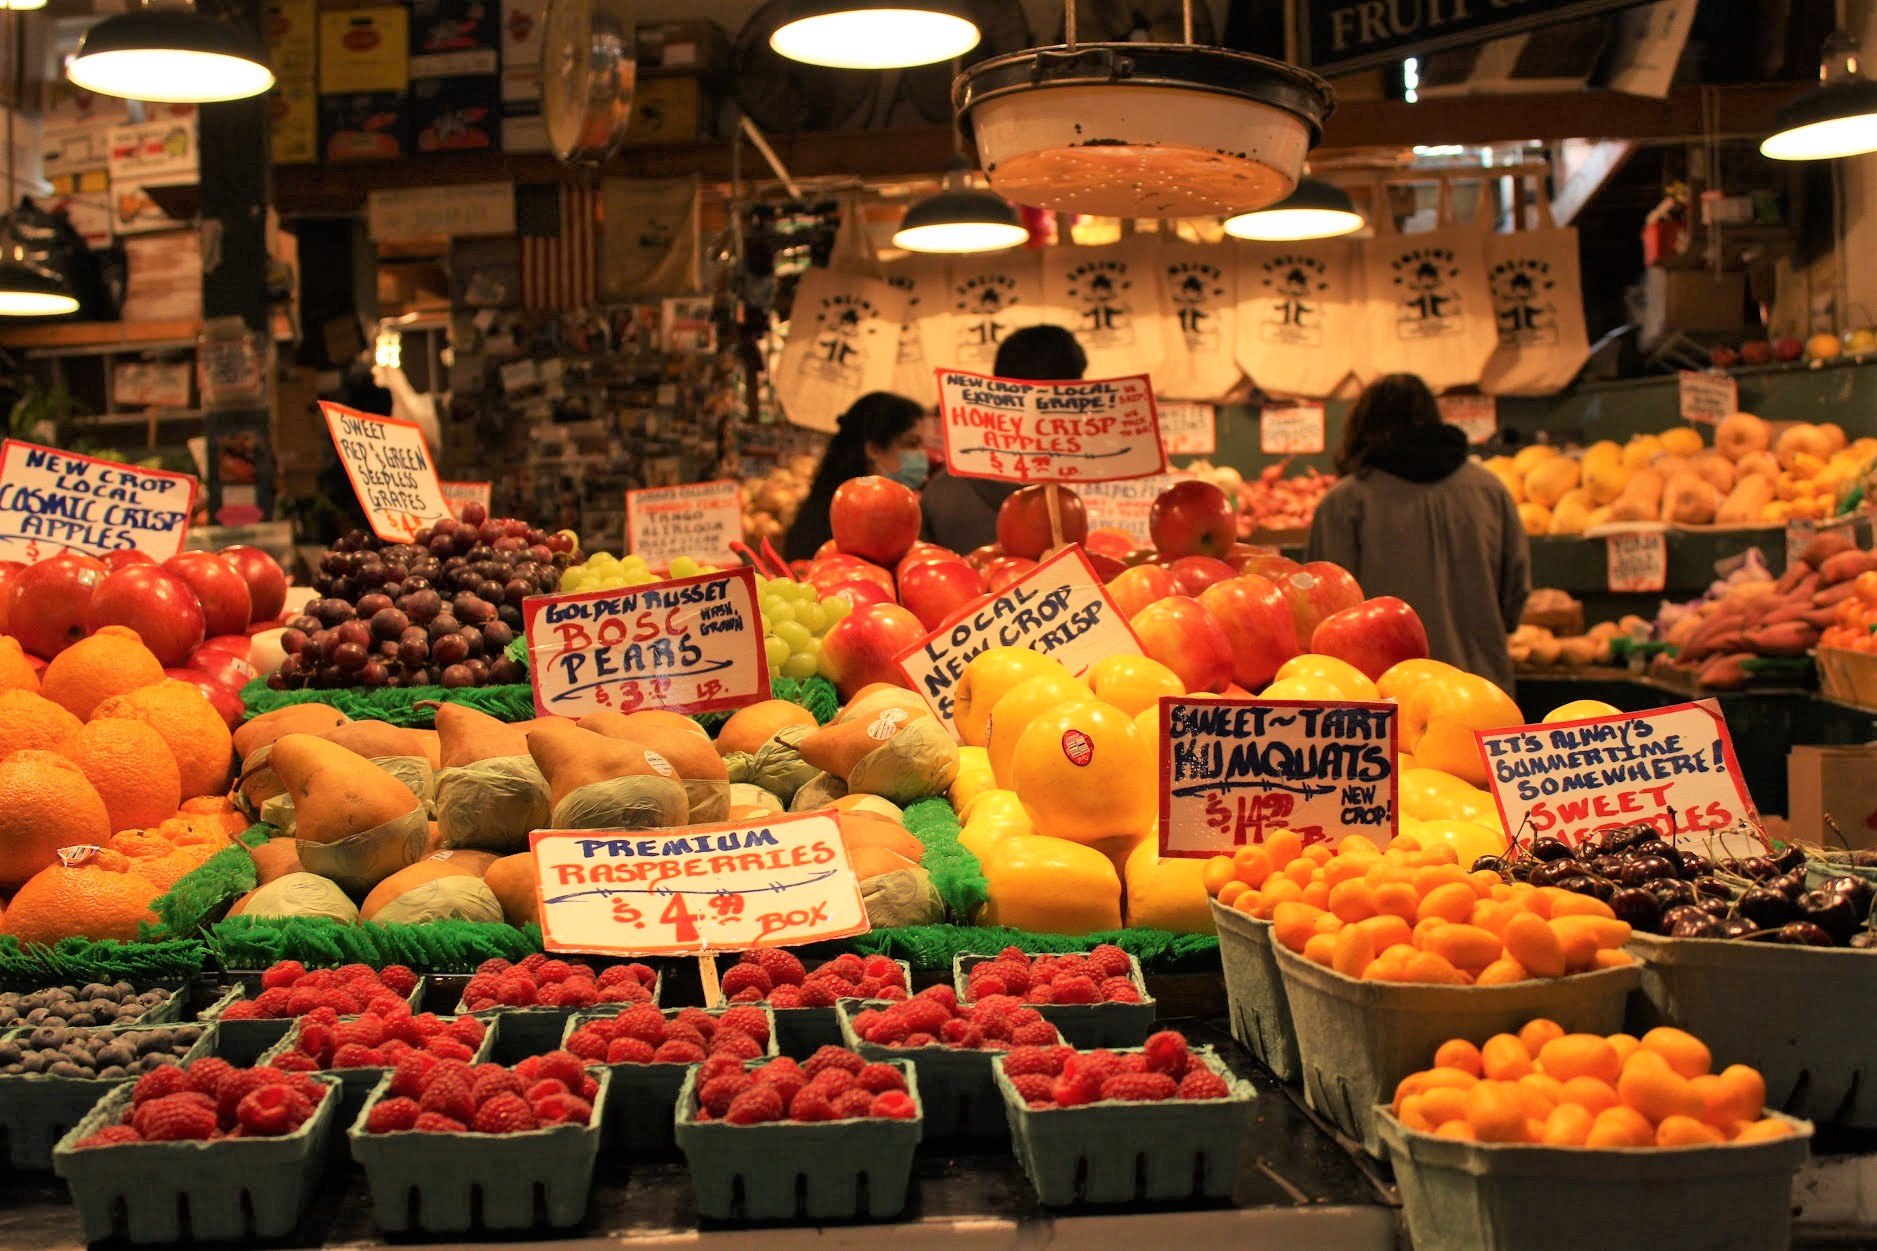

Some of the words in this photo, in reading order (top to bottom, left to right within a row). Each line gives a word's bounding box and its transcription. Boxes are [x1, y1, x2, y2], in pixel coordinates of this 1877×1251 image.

[947, 375, 983, 388] NEW
[986, 380, 1034, 394] CROP
[1052, 384, 1119, 396] LOCAL
[962, 390, 1025, 407] EXPORT
[340, 414, 386, 440] SWEET
[951, 406, 1024, 437] HONEY
[1035, 417, 1117, 437] CRISP
[383, 444, 427, 471] GREEN
[983, 432, 1081, 453] APPLES
[26, 449, 90, 476] NEW
[99, 470, 176, 493] CROP
[0, 484, 98, 522] COSMIC
[103, 505, 188, 531] CRISP
[56, 476, 141, 504] LOCAL
[367, 488, 426, 511] GRAPES
[20, 516, 137, 549] APPLES
[546, 595, 637, 624] GOLDEN
[642, 578, 731, 611] RUSSET
[547, 607, 689, 664] BOSC
[700, 616, 744, 636] GROWN
[924, 637, 990, 697] NEW
[999, 585, 1071, 646] CROP
[925, 588, 1039, 663] LOCAL
[561, 633, 702, 685] PEARS
[1484, 732, 1544, 757] IT'S
[1550, 718, 1653, 750] ALWAY'S
[1174, 739, 1391, 782] KUMQUATS
[1496, 735, 1684, 783] SUMMERTIME
[1518, 739, 1726, 801] SOMEWHERE!
[1341, 785, 1376, 806] NEW
[1341, 800, 1391, 826] CROP!
[1530, 782, 1675, 832] SWEET
[575, 828, 779, 858] PREMIUM
[550, 841, 835, 886] RASPBERRIES
[756, 901, 828, 938] BOX
